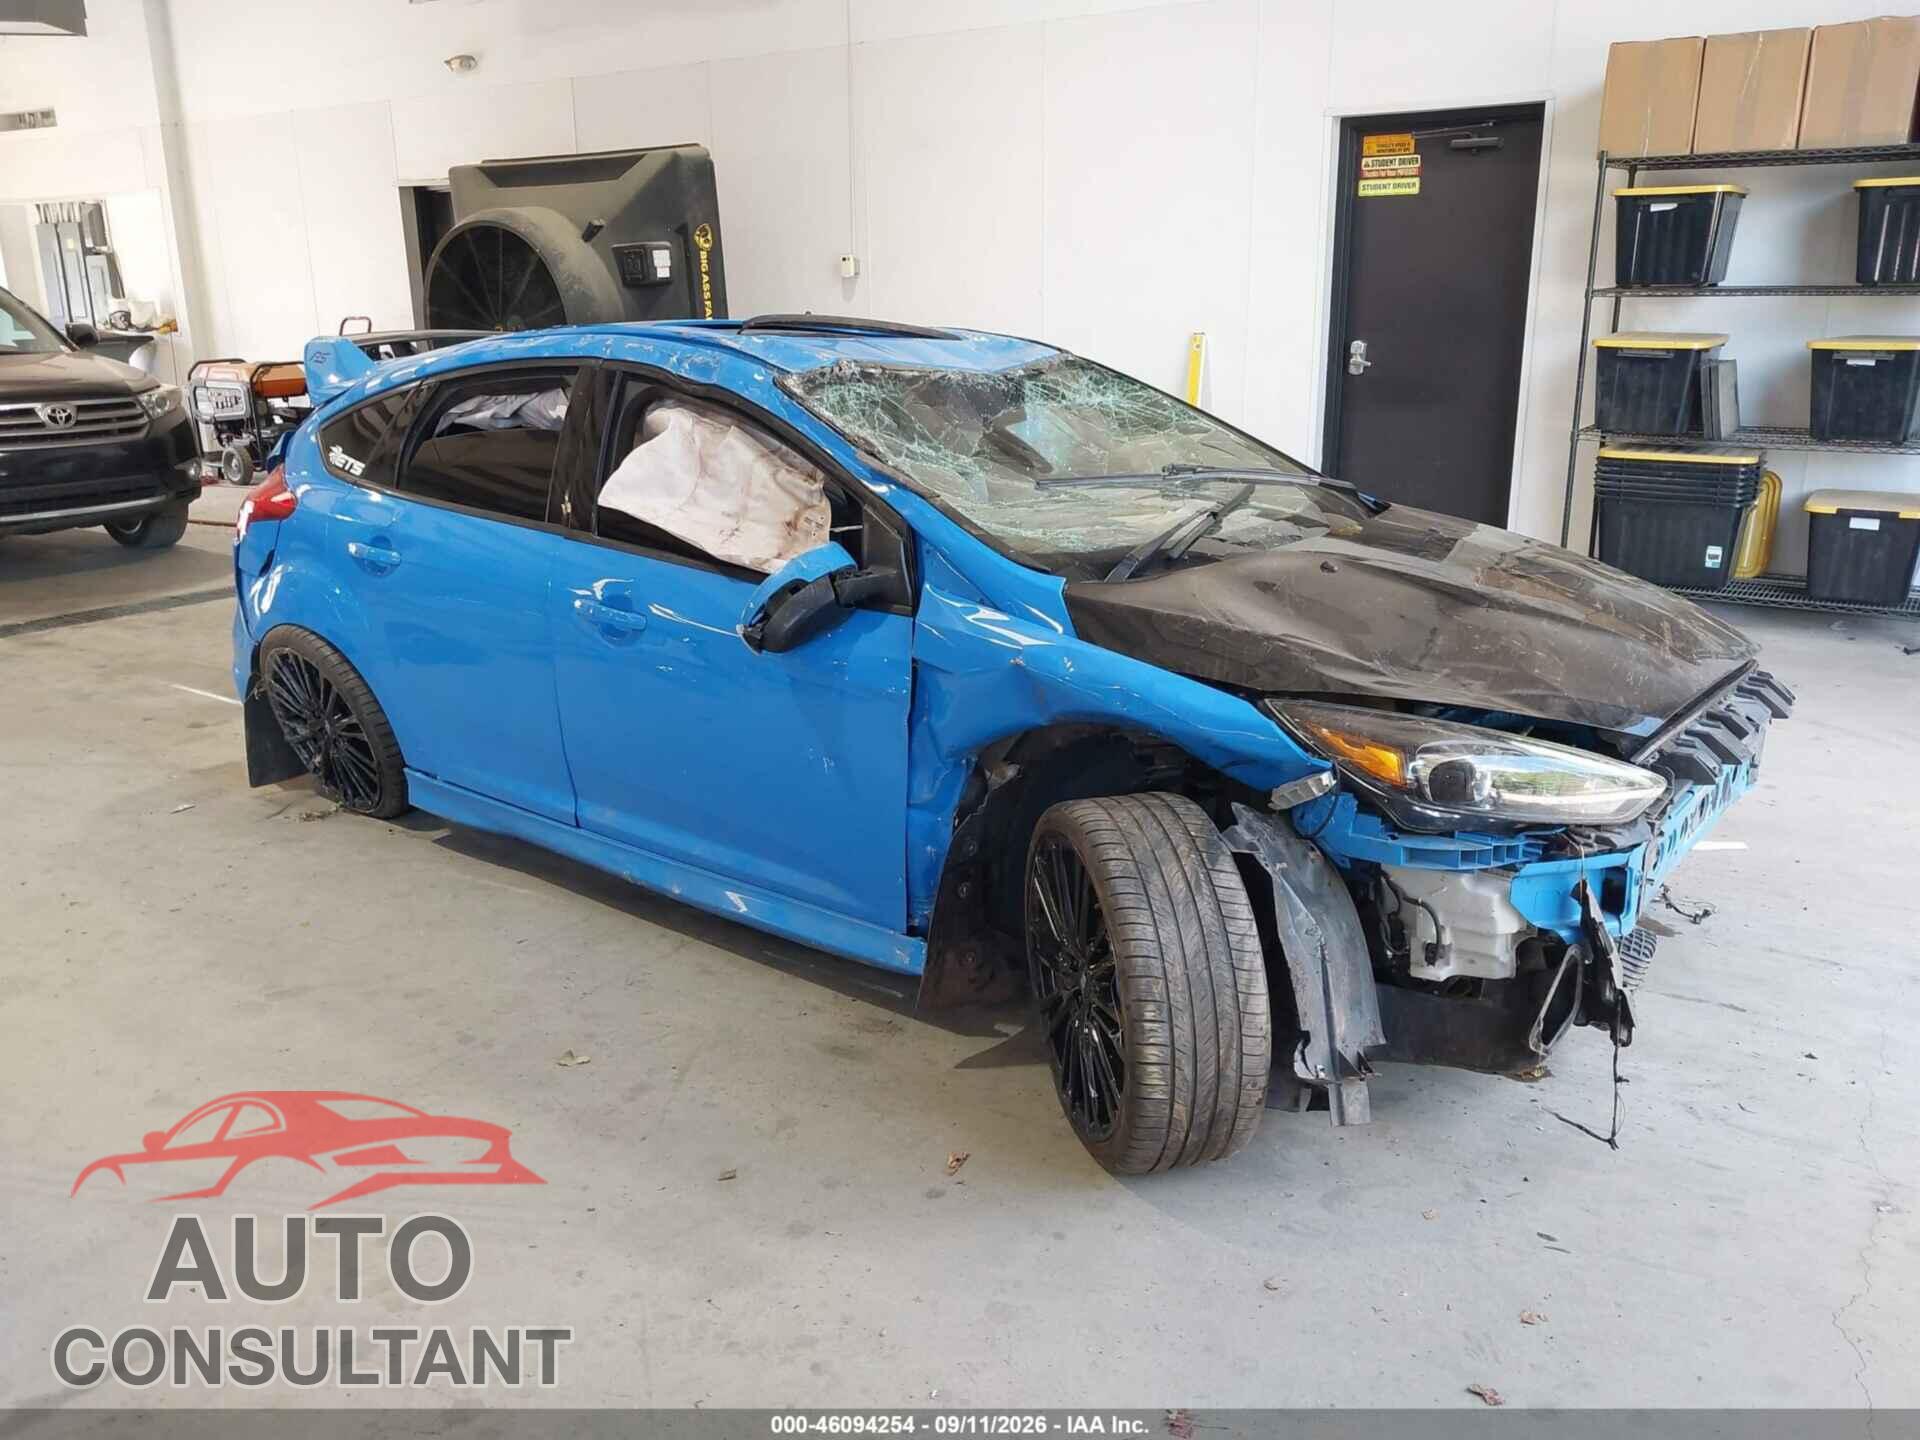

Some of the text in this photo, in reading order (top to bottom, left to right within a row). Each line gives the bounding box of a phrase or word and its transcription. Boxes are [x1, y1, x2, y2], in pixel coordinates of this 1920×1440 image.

[1371, 156, 1419, 168] STUDENT DRIVER
[1361, 182, 1417, 192] STUDENT DRIVER
[700, 250, 709, 273] BIG
[702, 273, 711, 300] ASS
